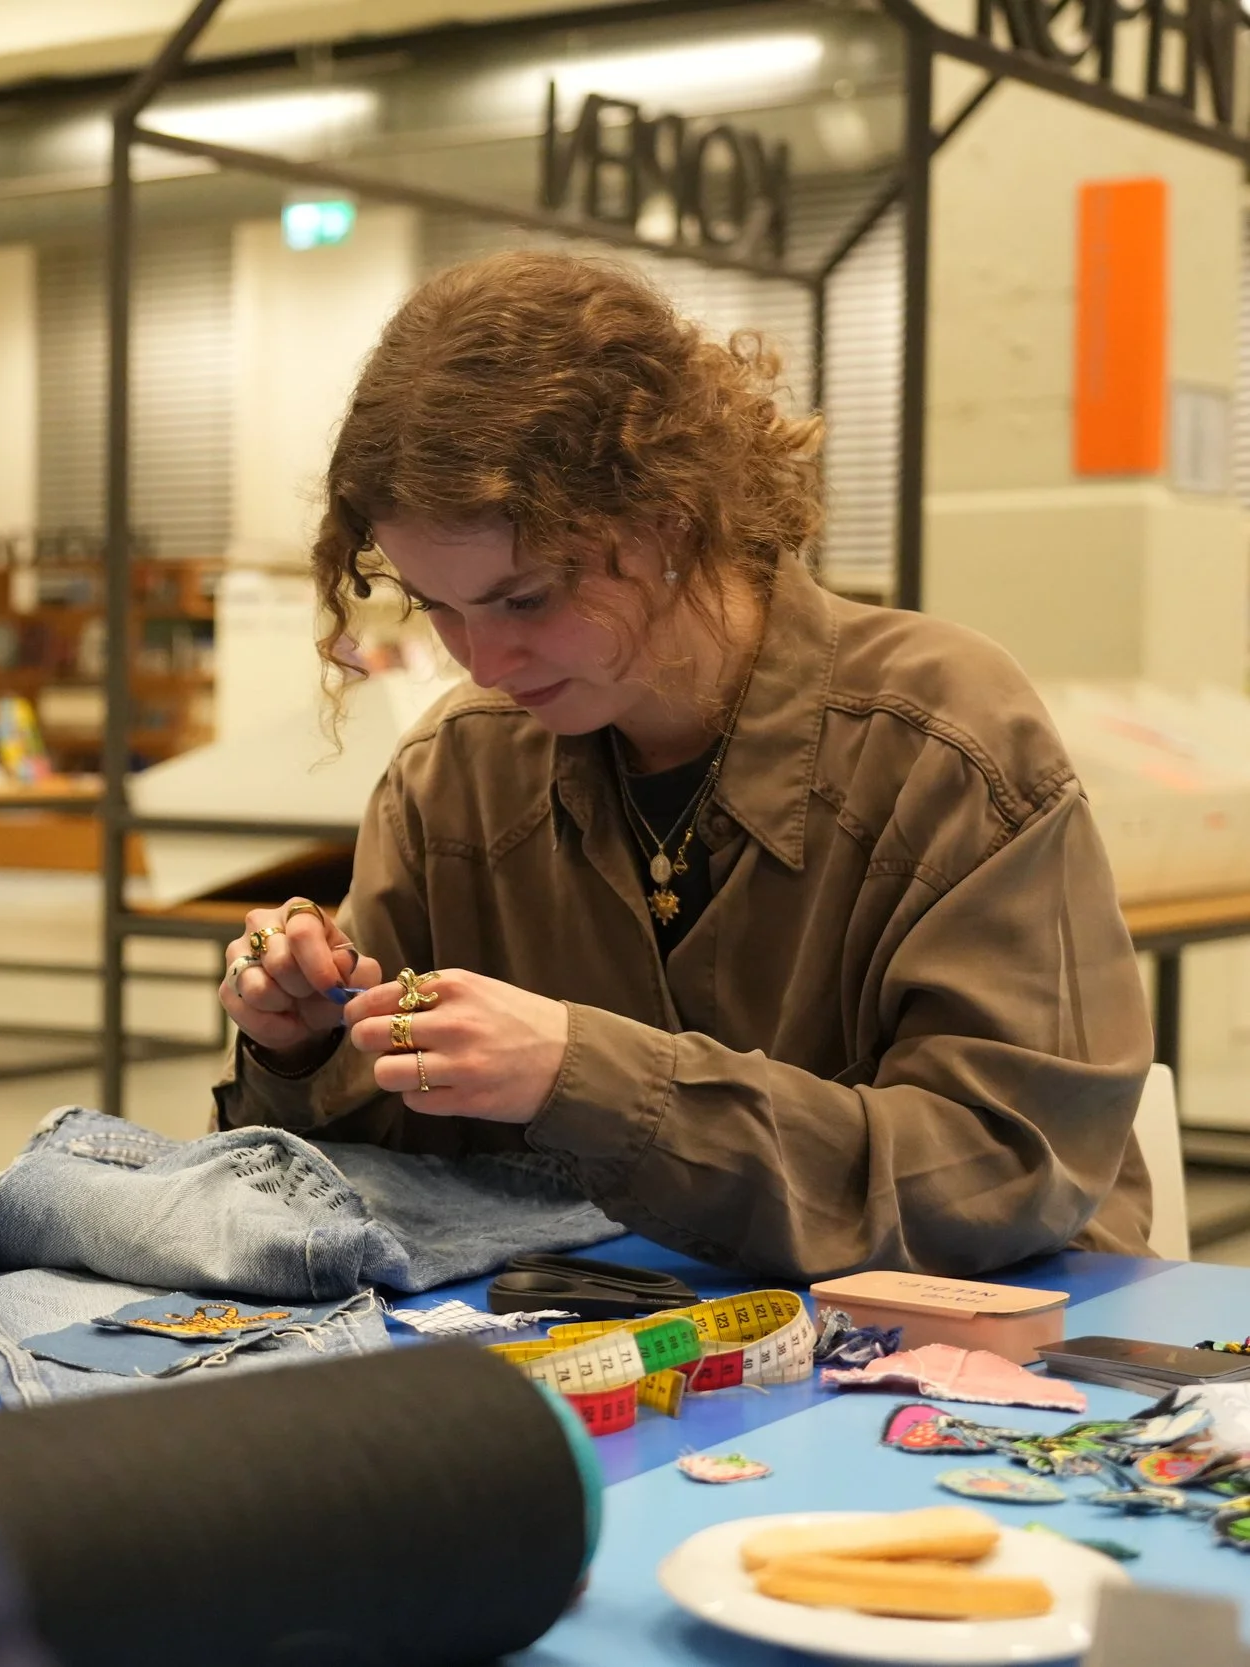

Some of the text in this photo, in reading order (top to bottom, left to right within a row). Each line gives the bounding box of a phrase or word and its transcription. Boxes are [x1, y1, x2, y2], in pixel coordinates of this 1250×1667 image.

[737, 1307, 750, 1324] 122
[757, 1304, 768, 1318] 121
[717, 1312, 729, 1329] 123
[791, 1332, 800, 1346] 37
[621, 1349, 633, 1363] 71
[777, 1341, 787, 1356] 38
[602, 1355, 614, 1371] 72
[743, 1358, 753, 1369] 40
[761, 1350, 771, 1364] 39
[558, 1367, 571, 1383] 74
[580, 1361, 593, 1377] 73
